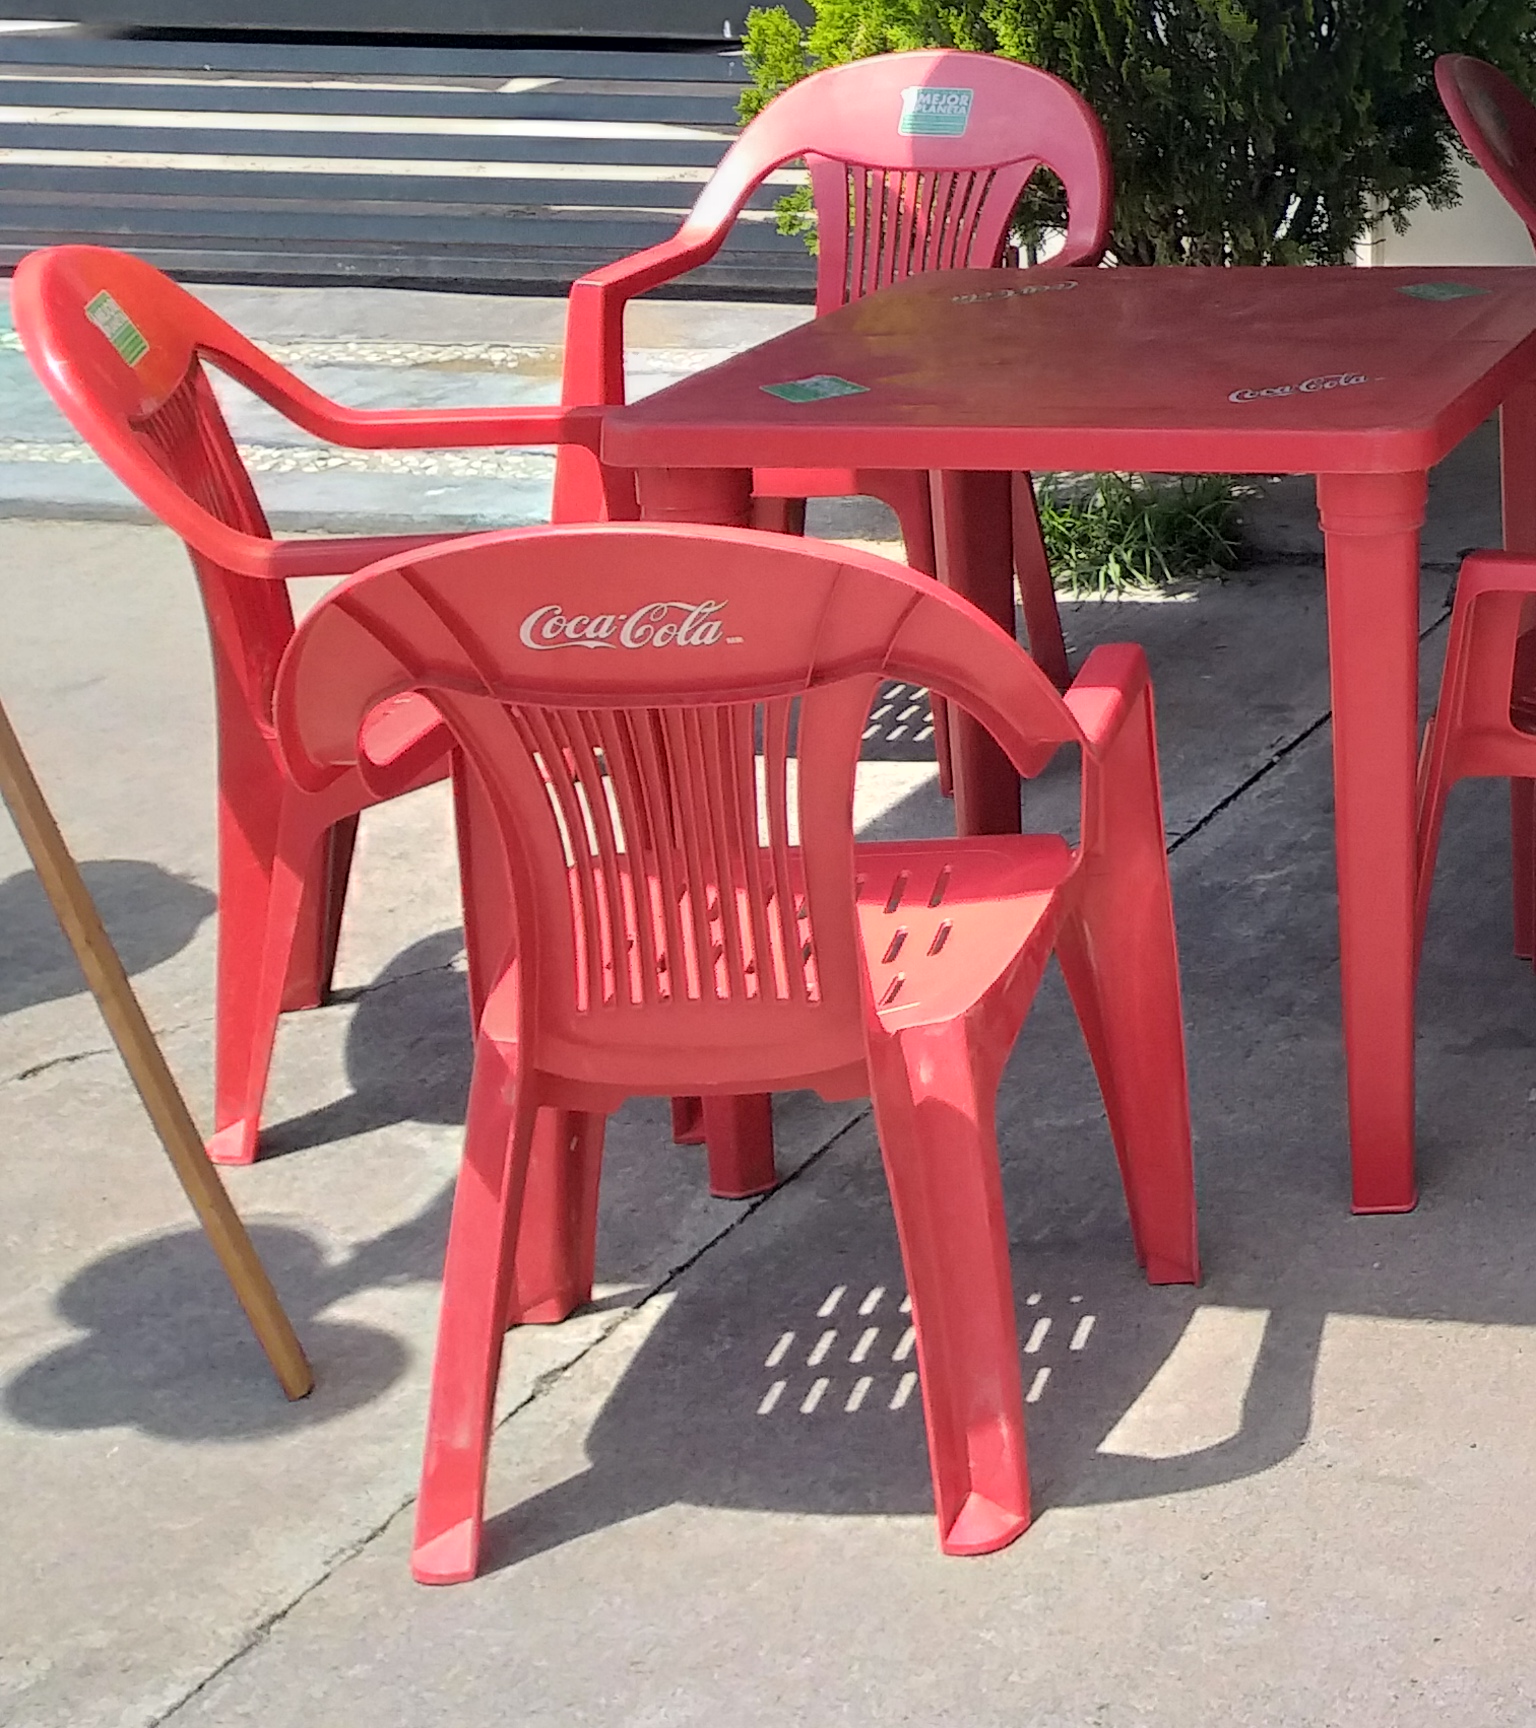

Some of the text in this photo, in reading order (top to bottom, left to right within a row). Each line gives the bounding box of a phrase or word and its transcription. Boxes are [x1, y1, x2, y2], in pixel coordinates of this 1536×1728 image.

[918, 93, 970, 107] MEJOR
[1228, 372, 1368, 404] Coca-Cola
[519, 599, 729, 650] Coca-Cola
